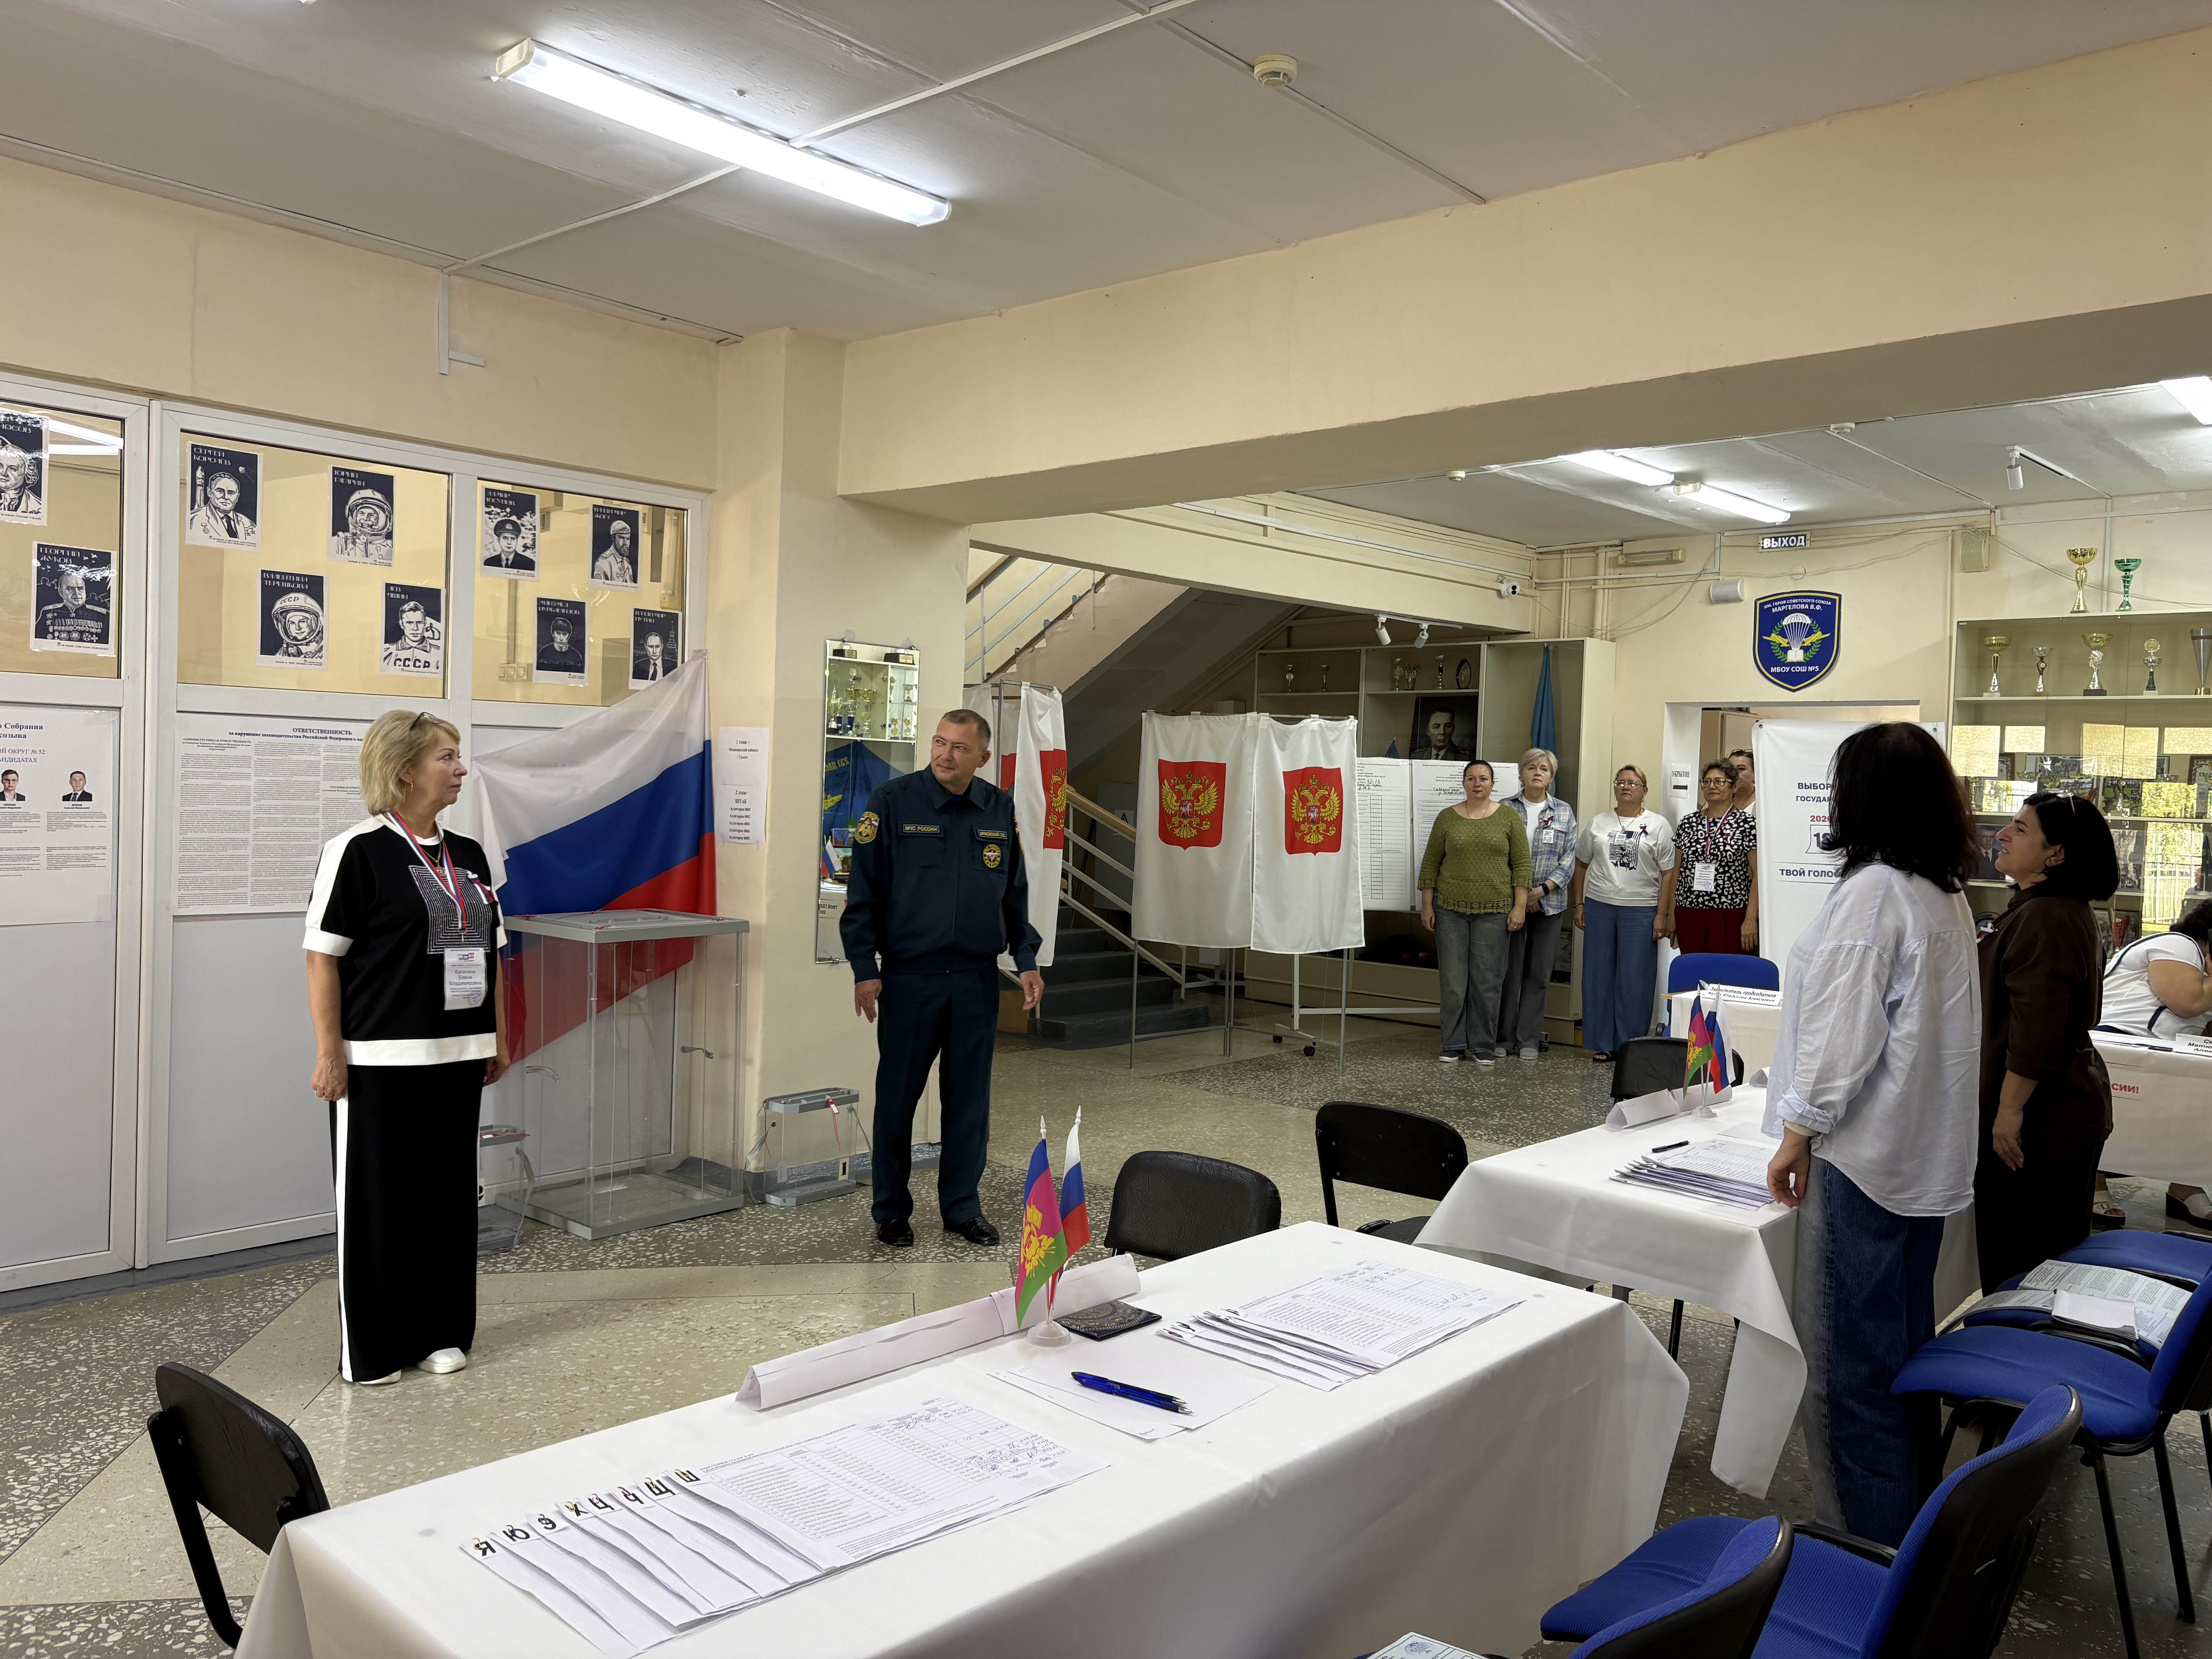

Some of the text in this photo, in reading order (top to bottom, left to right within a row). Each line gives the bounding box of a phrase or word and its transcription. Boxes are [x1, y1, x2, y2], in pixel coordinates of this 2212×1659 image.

[1764, 536, 1805, 548] ВЫХОД
[40, 555, 72, 564] ЖУКОВ
[1772, 604, 1809, 613] МАРГЕЛОВА
[393, 658, 431, 669] СССР
[4, 723, 43, 731] Собрания
[1779, 868, 1805, 877] ТВОЙ
[502, 1530, 530, 1542] Ю
[475, 1540, 496, 1556] Я
